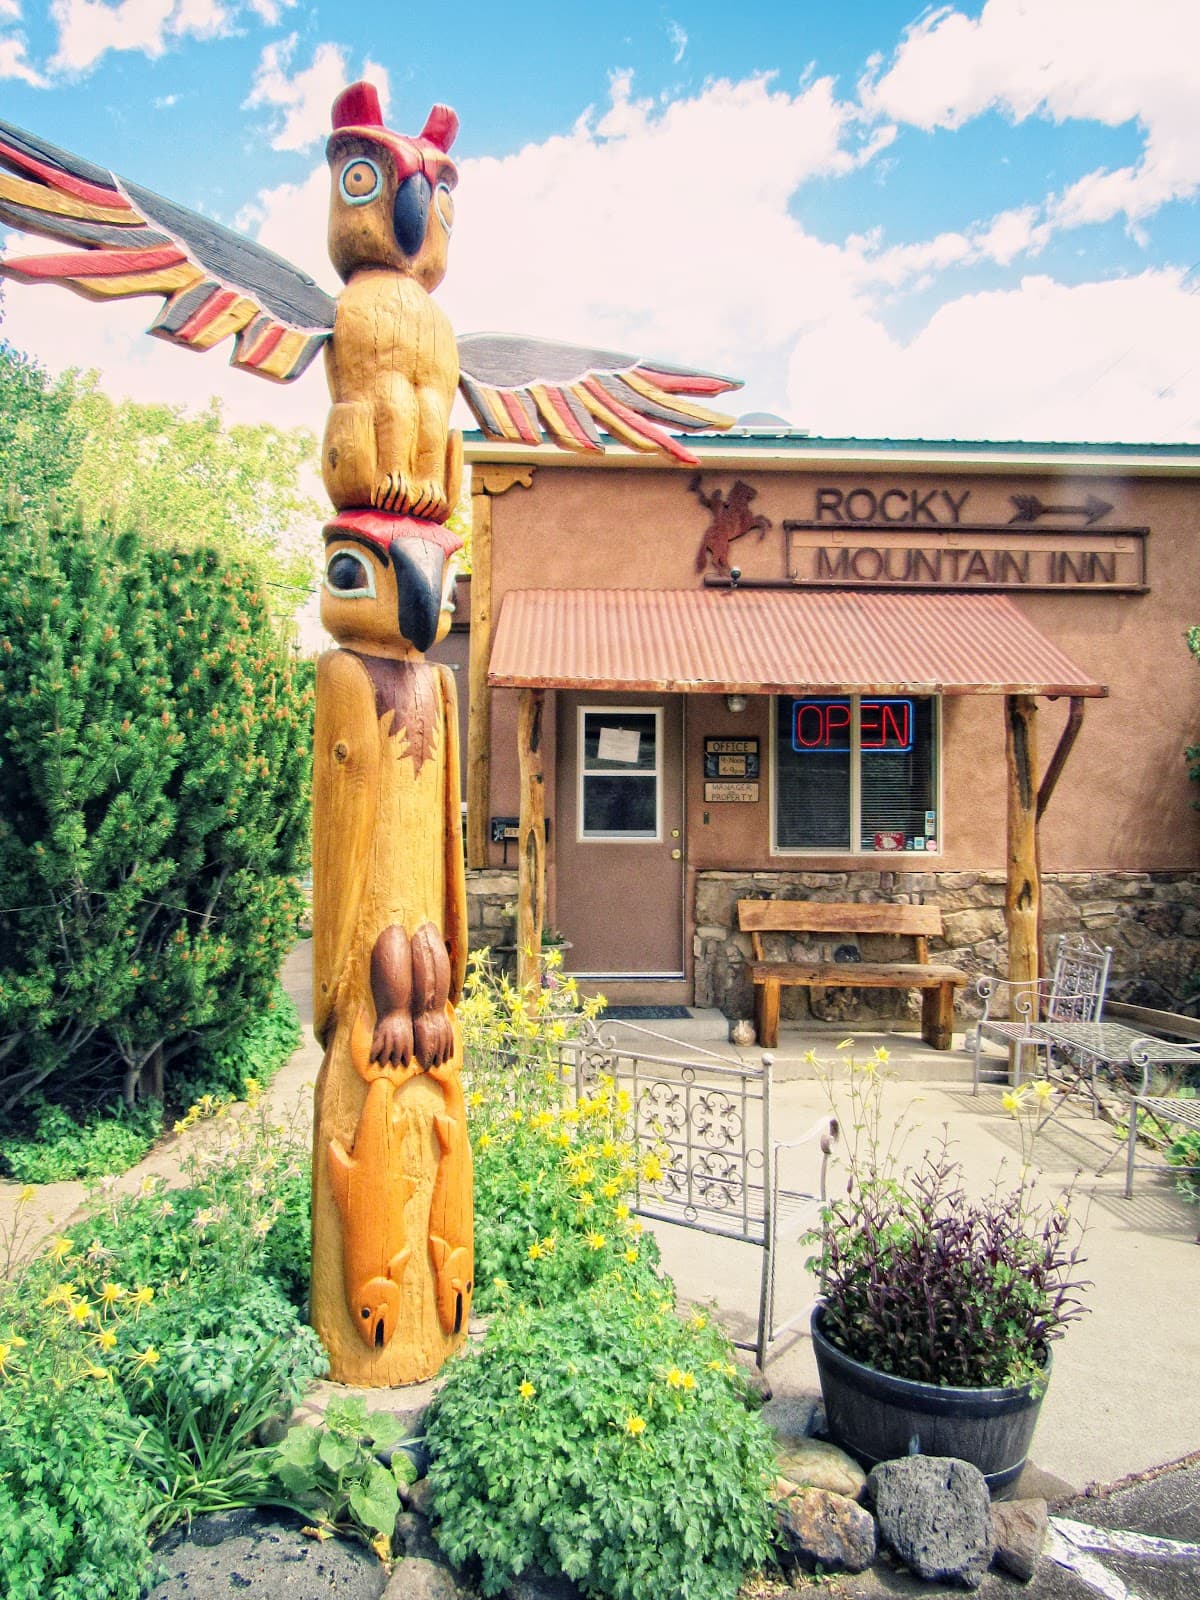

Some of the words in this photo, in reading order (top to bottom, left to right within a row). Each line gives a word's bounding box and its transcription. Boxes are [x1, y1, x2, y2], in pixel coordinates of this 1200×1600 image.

[816, 487, 970, 523] ROCKY
[815, 547, 1030, 583] MOUNTAIN
[1047, 551, 1116, 583] INN
[797, 705, 908, 746] OPEN
[712, 742, 749, 752] OFFICE
[711, 793, 753, 801] PROPERTY
